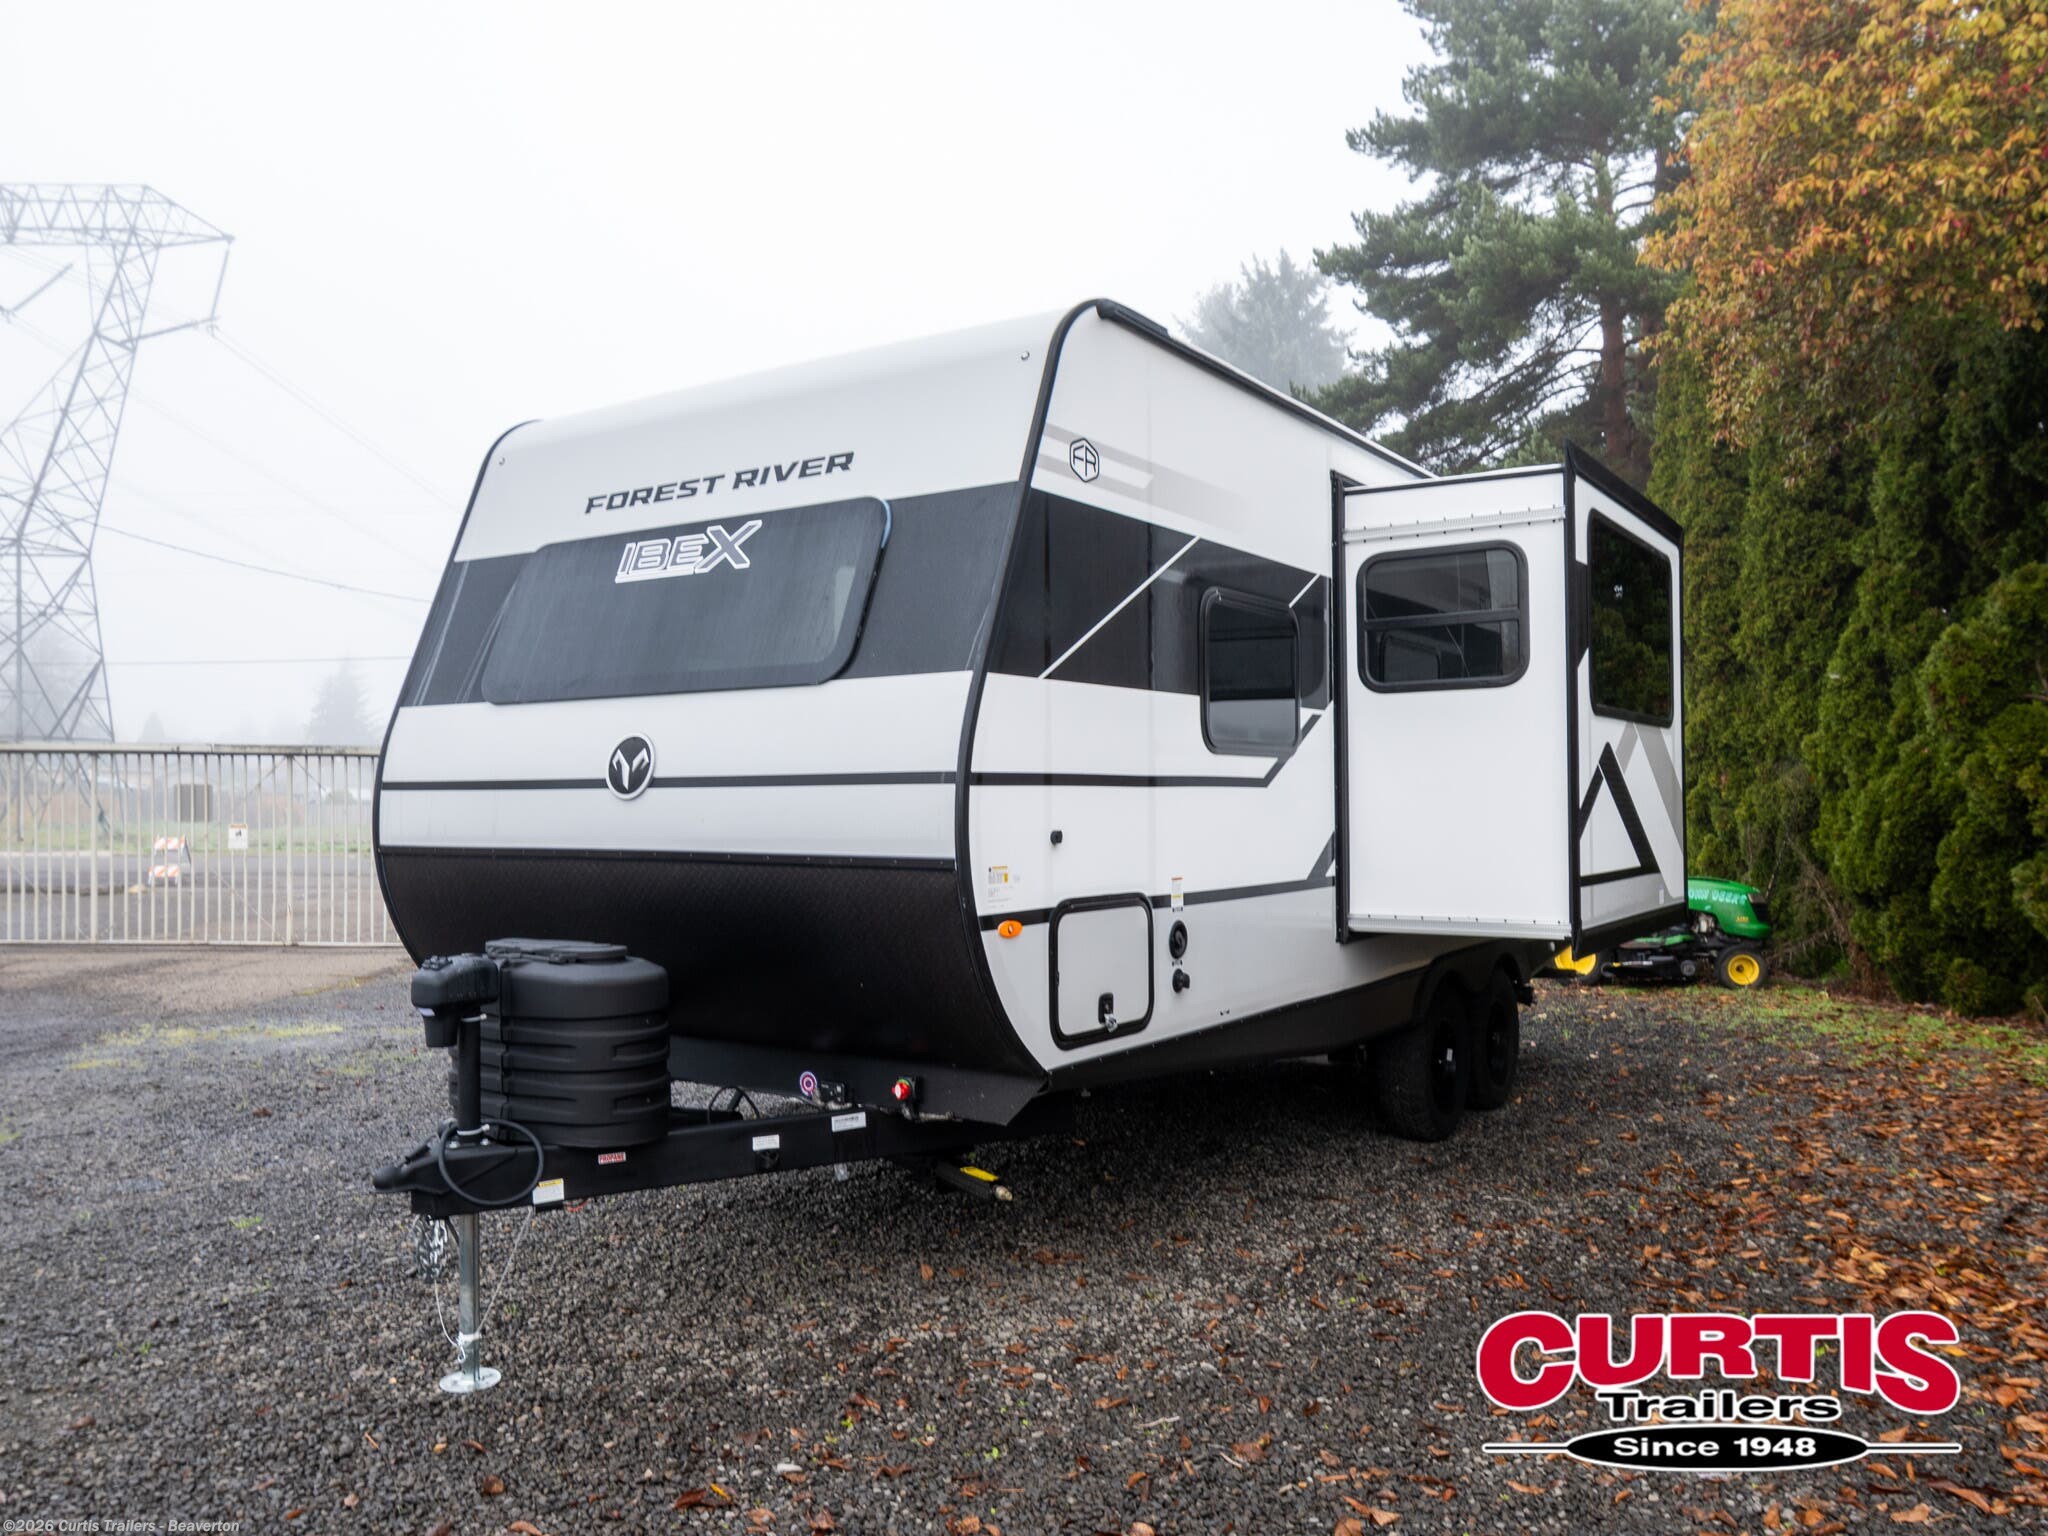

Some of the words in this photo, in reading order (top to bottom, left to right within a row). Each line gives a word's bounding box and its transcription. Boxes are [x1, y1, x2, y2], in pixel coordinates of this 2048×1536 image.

[584, 475, 725, 514] FOREST
[732, 451, 855, 490] RIVER
[615, 519, 763, 583] IBEX
[1688, 888, 1709, 900] OHN
